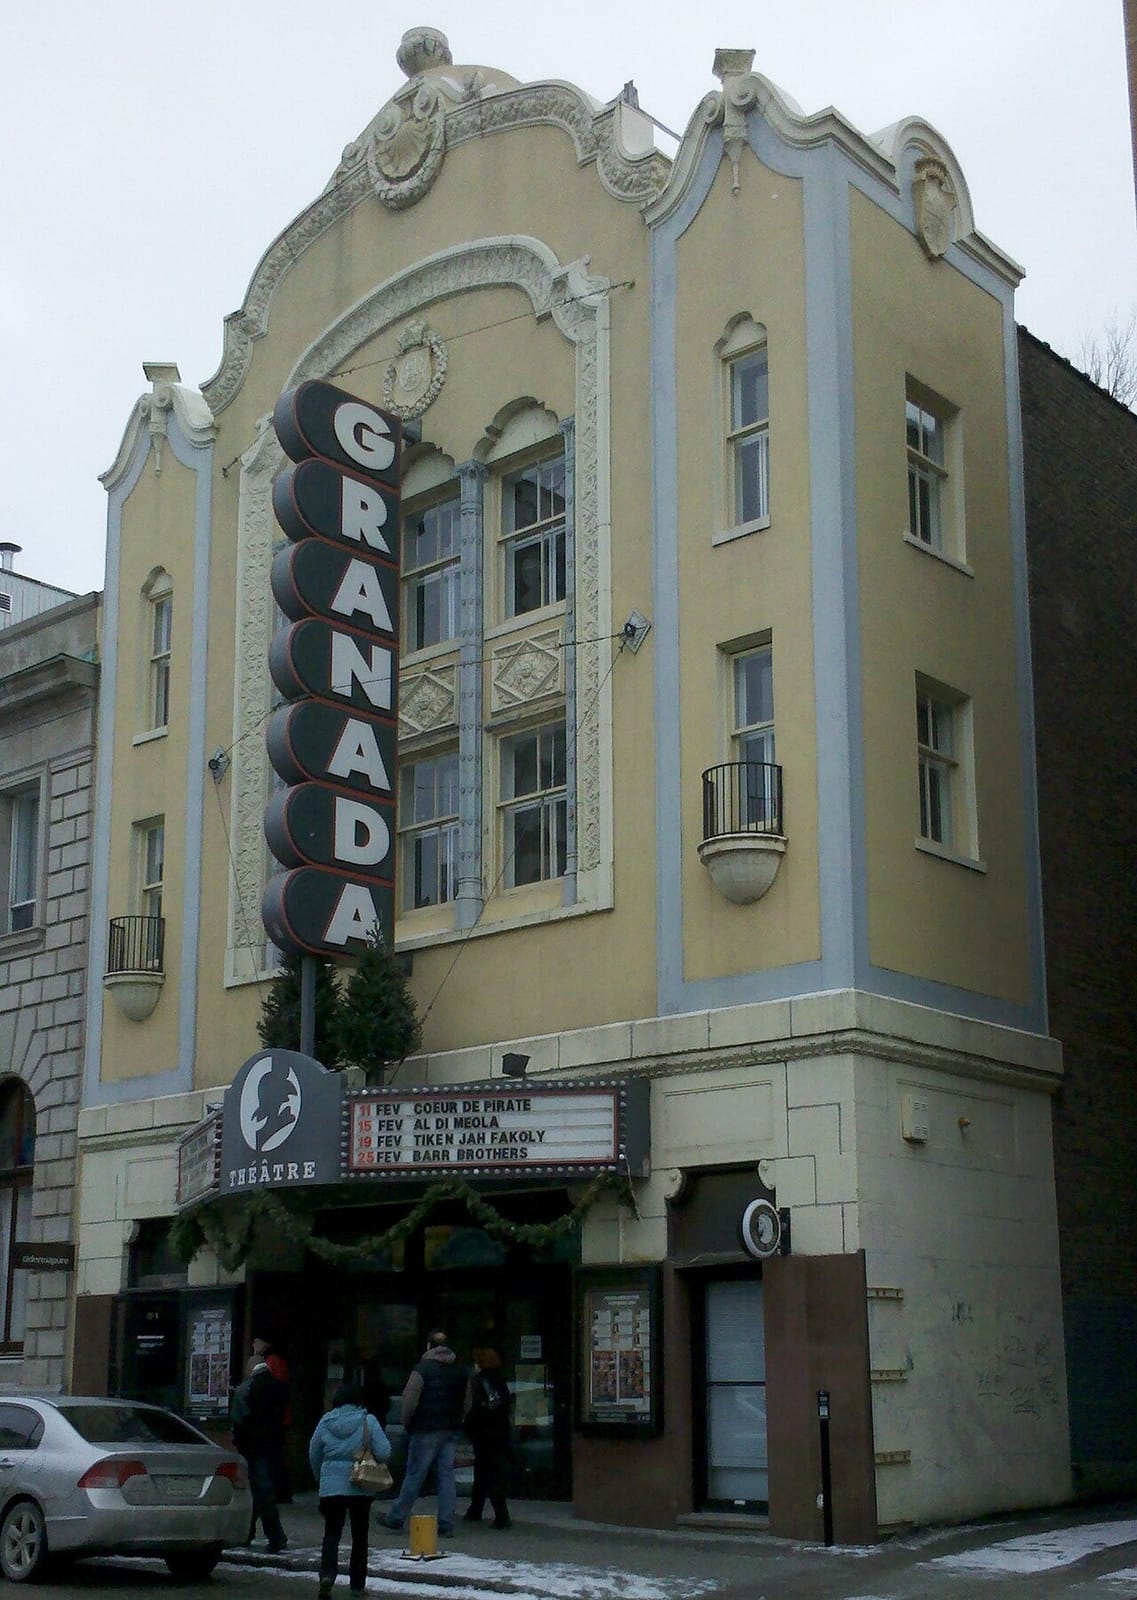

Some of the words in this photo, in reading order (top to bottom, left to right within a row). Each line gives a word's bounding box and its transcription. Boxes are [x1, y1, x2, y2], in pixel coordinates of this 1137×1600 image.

[323, 401, 397, 948] GRANADA
[359, 1104, 371, 1117] 11
[376, 1103, 401, 1116] FEV
[414, 1099, 458, 1114] COEUR
[462, 1099, 480, 1113] DE
[483, 1098, 532, 1112] PIRATE
[358, 1119, 372, 1132] 15
[378, 1118, 403, 1132] FEV
[413, 1117, 431, 1130] AL
[435, 1116, 449, 1129] DI
[453, 1114, 500, 1129] MEOLA
[358, 1136, 372, 1149] 19
[377, 1135, 402, 1148] FEV
[414, 1132, 454, 1146] TIKEN
[458, 1131, 486, 1145] JAH
[490, 1130, 546, 1144] FAKOLY
[357, 1151, 374, 1164] 25
[376, 1150, 401, 1163] FEV
[413, 1148, 450, 1162] BARR
[456, 1146, 529, 1161] BROTHERS
[229, 1158, 317, 1188] THÉÂTRE
